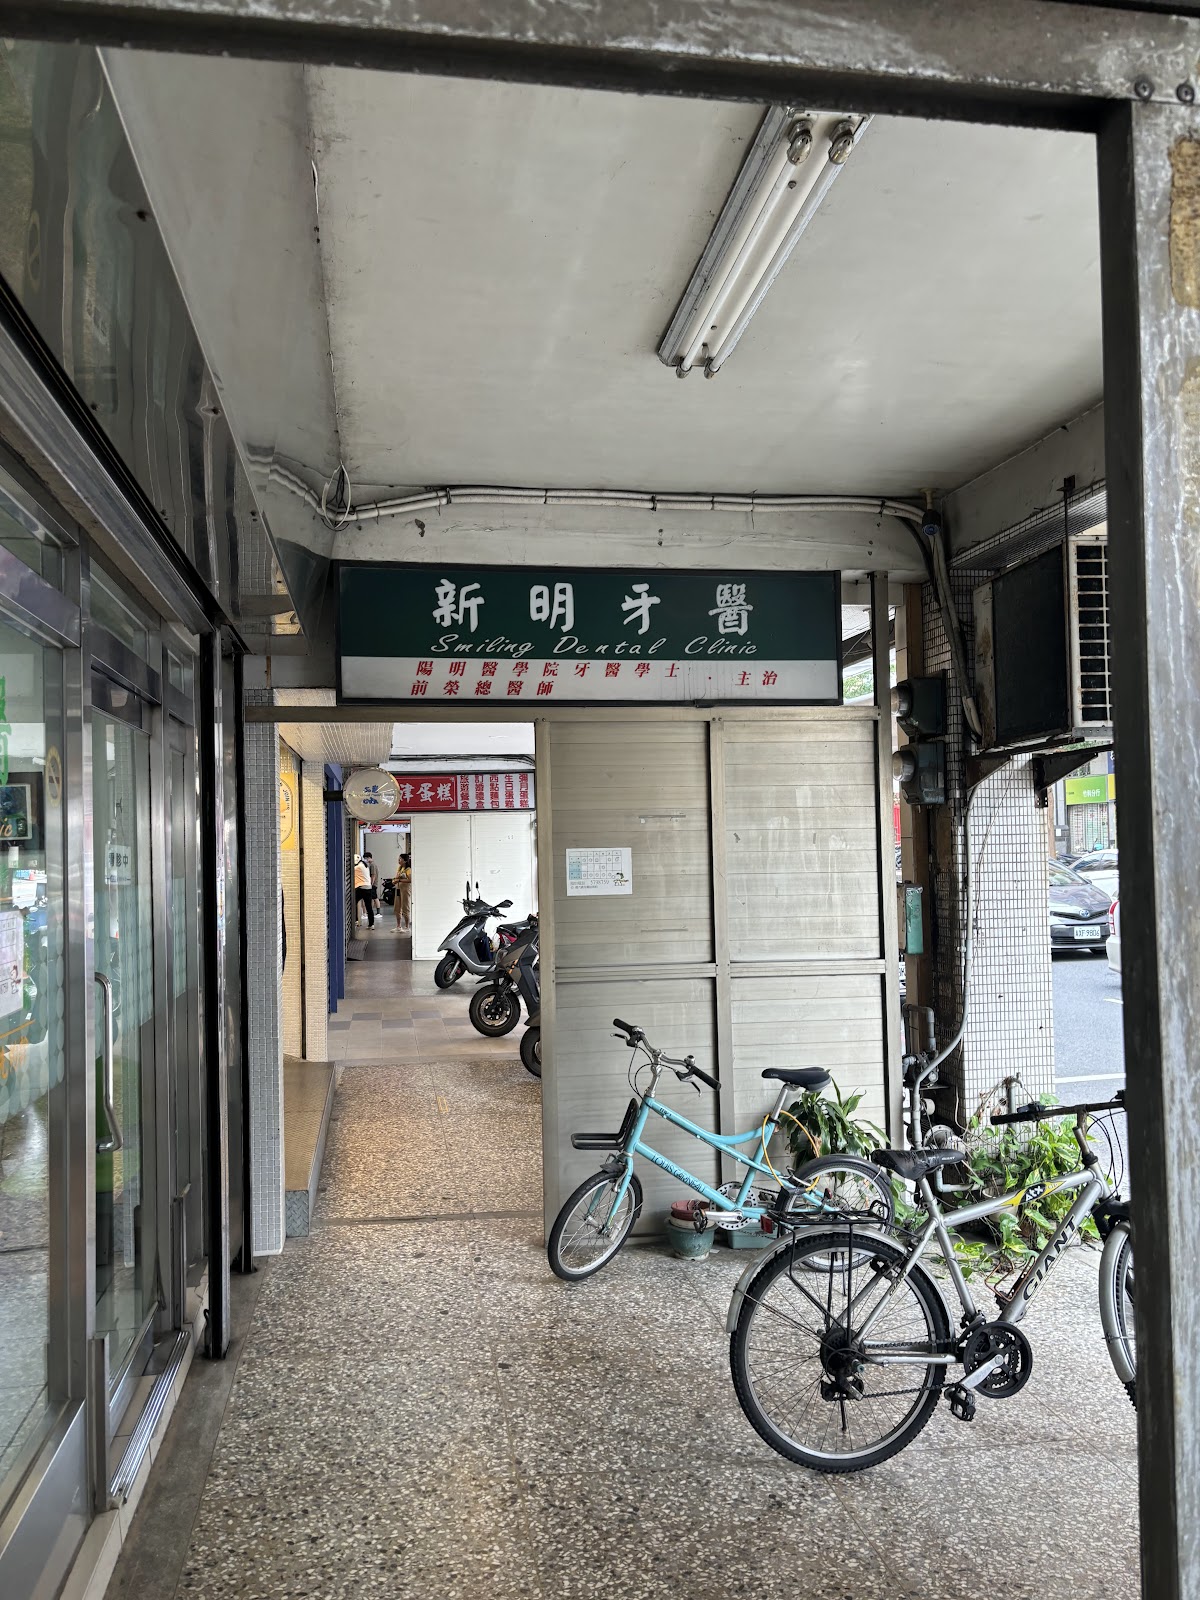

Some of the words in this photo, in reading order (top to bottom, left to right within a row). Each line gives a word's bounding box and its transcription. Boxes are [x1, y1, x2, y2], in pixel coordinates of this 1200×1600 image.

[432, 578, 754, 636] 新明牙醫
[430, 633, 536, 658] Smiling
[552, 635, 667, 655] Dental
[684, 636, 758, 655] Clinic
[410, 680, 554, 696] 前榮總醫師
[650, 1153, 676, 1174] LOUIS
[673, 1168, 706, 1194] GARNEAU
[1023, 1214, 1077, 1301] GIANT
